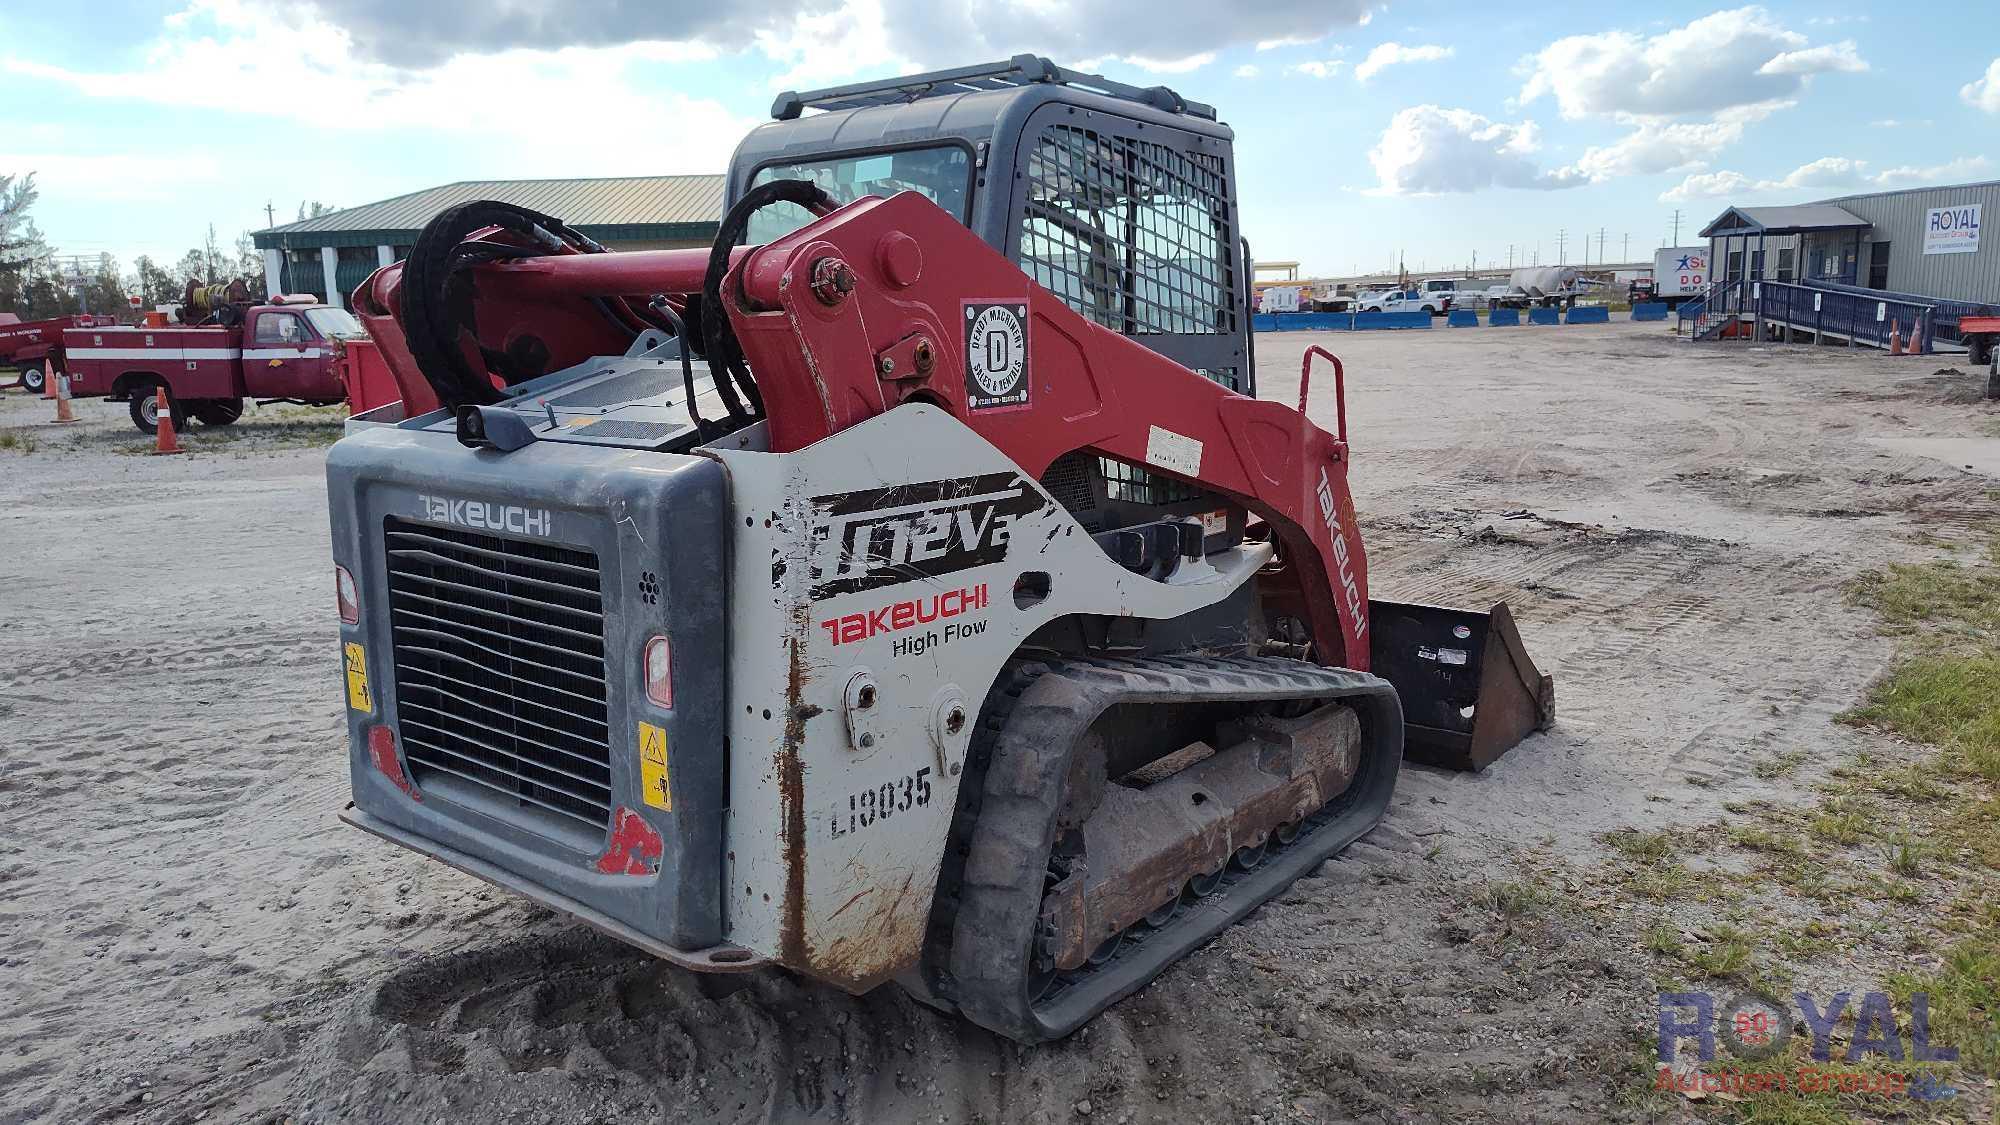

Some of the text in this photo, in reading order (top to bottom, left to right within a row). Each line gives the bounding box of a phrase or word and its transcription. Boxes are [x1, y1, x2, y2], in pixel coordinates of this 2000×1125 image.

[1931, 209, 1978, 230] ROYAL
[972, 309, 1022, 350] DENDY MACHINERY
[986, 330, 1008, 372] D
[974, 360, 1022, 391] SALES & RENTALS
[419, 495, 550, 536] TAKEUCHI
[1316, 465, 1366, 640] TAKEUCHI
[821, 584, 988, 646] TAKEUCHI
[893, 619, 988, 658] High Flow
